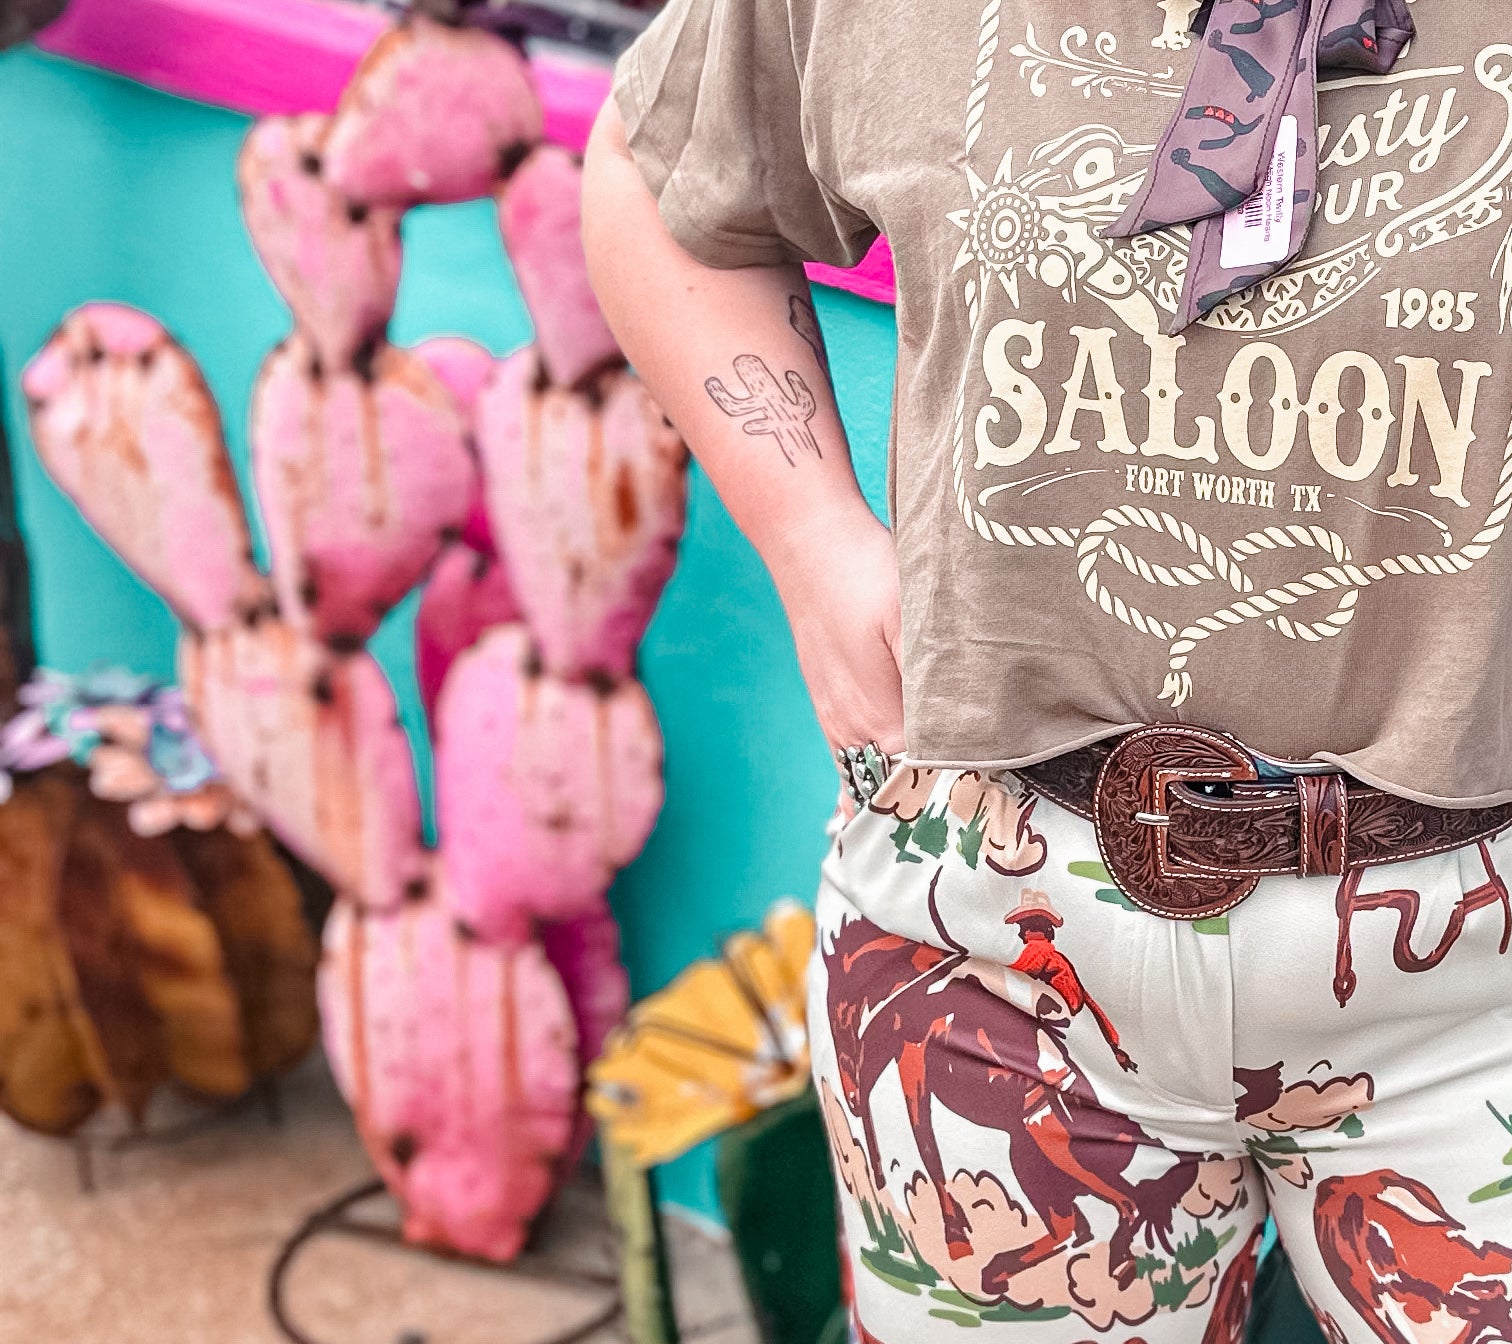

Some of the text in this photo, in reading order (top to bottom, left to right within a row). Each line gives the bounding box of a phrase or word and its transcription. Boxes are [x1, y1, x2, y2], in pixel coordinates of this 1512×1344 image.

[1382, 288, 1479, 334] 1985
[974, 316, 1492, 508] SALOON
[1125, 464, 1323, 514] FORT WORTH TX
